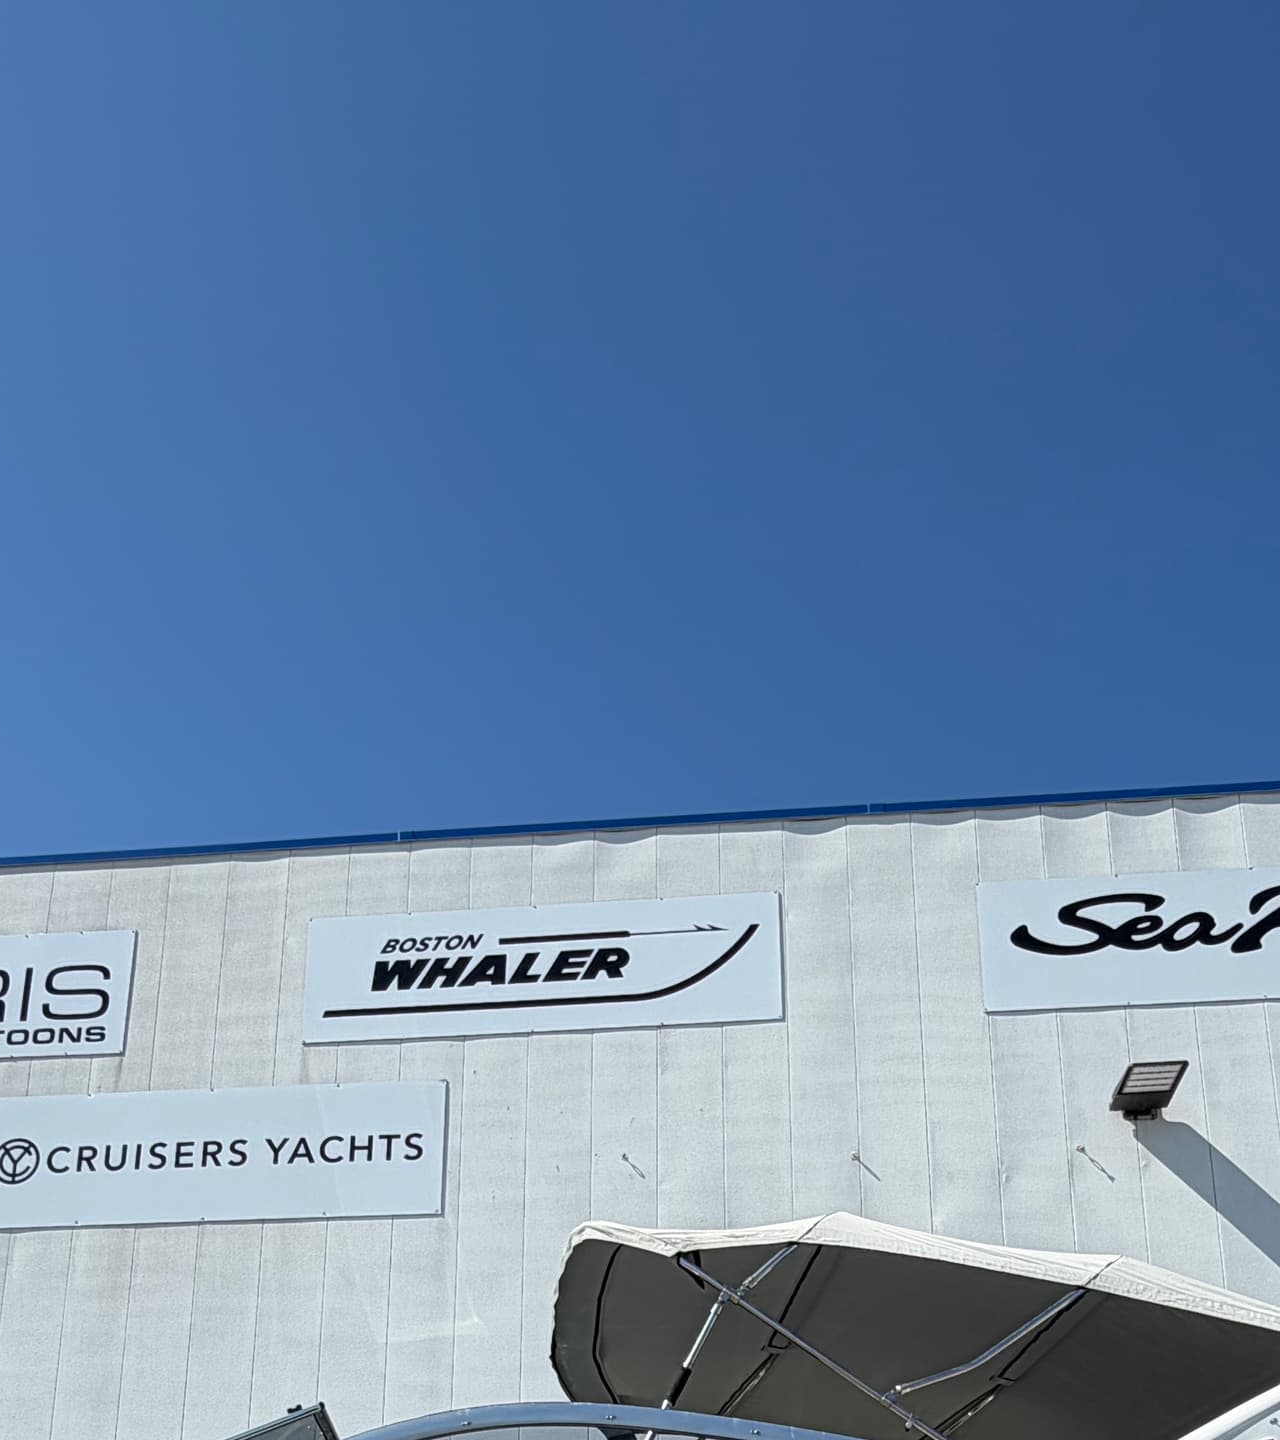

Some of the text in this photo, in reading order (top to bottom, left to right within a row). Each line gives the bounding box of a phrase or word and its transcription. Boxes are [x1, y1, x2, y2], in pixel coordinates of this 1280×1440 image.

[380, 932, 484, 955] BOSTON
[1010, 892, 1244, 956] Sea
[371, 946, 631, 993] WHALER
[46, 1138, 249, 1174] CRUISERS
[265, 1132, 424, 1165] YACHTS
